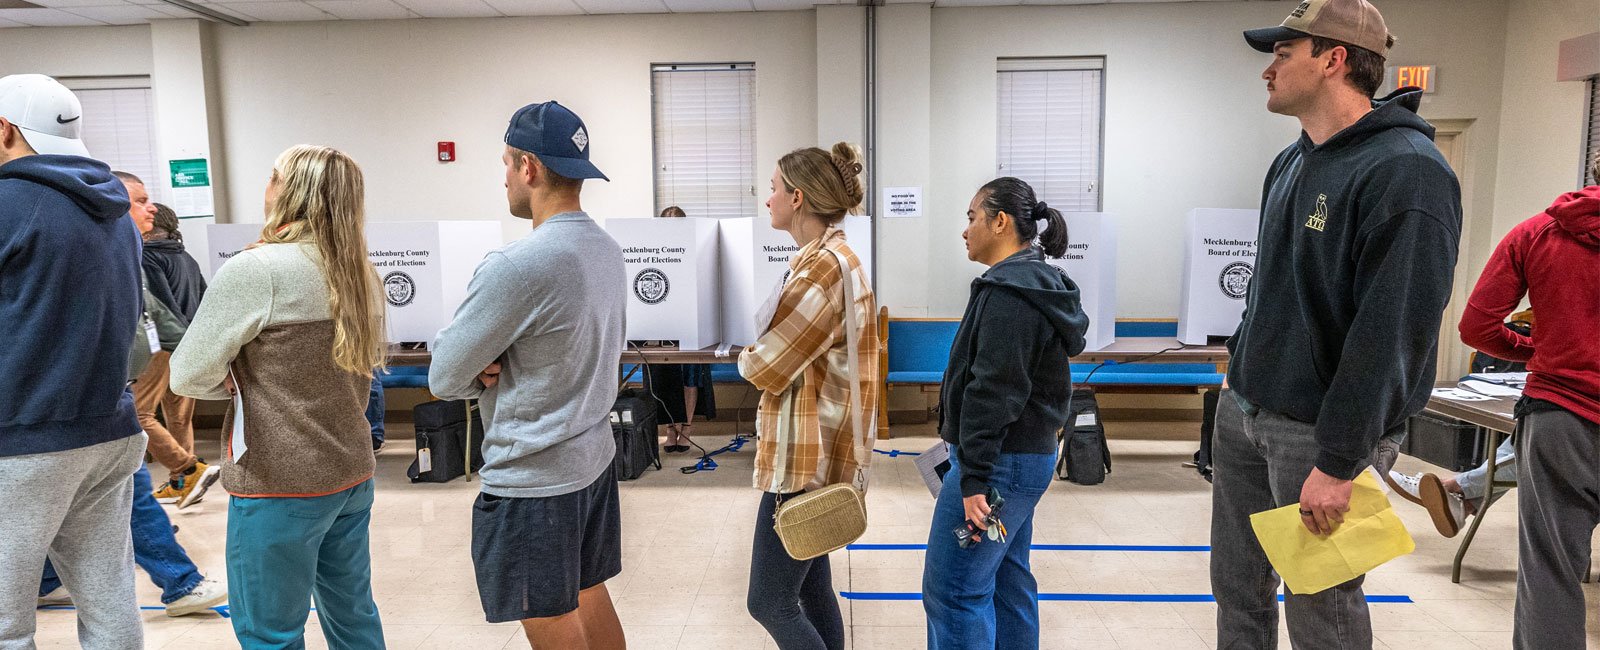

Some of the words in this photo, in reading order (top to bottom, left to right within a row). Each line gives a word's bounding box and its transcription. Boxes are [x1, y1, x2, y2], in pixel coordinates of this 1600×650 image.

[1398, 66, 1430, 90] EXIT
[1204, 239, 1251, 247] Mecklenburg
[406, 249, 429, 257] County
[661, 246, 686, 254] County
[1232, 249, 1240, 257] of
[397, 259, 426, 267] Elections
